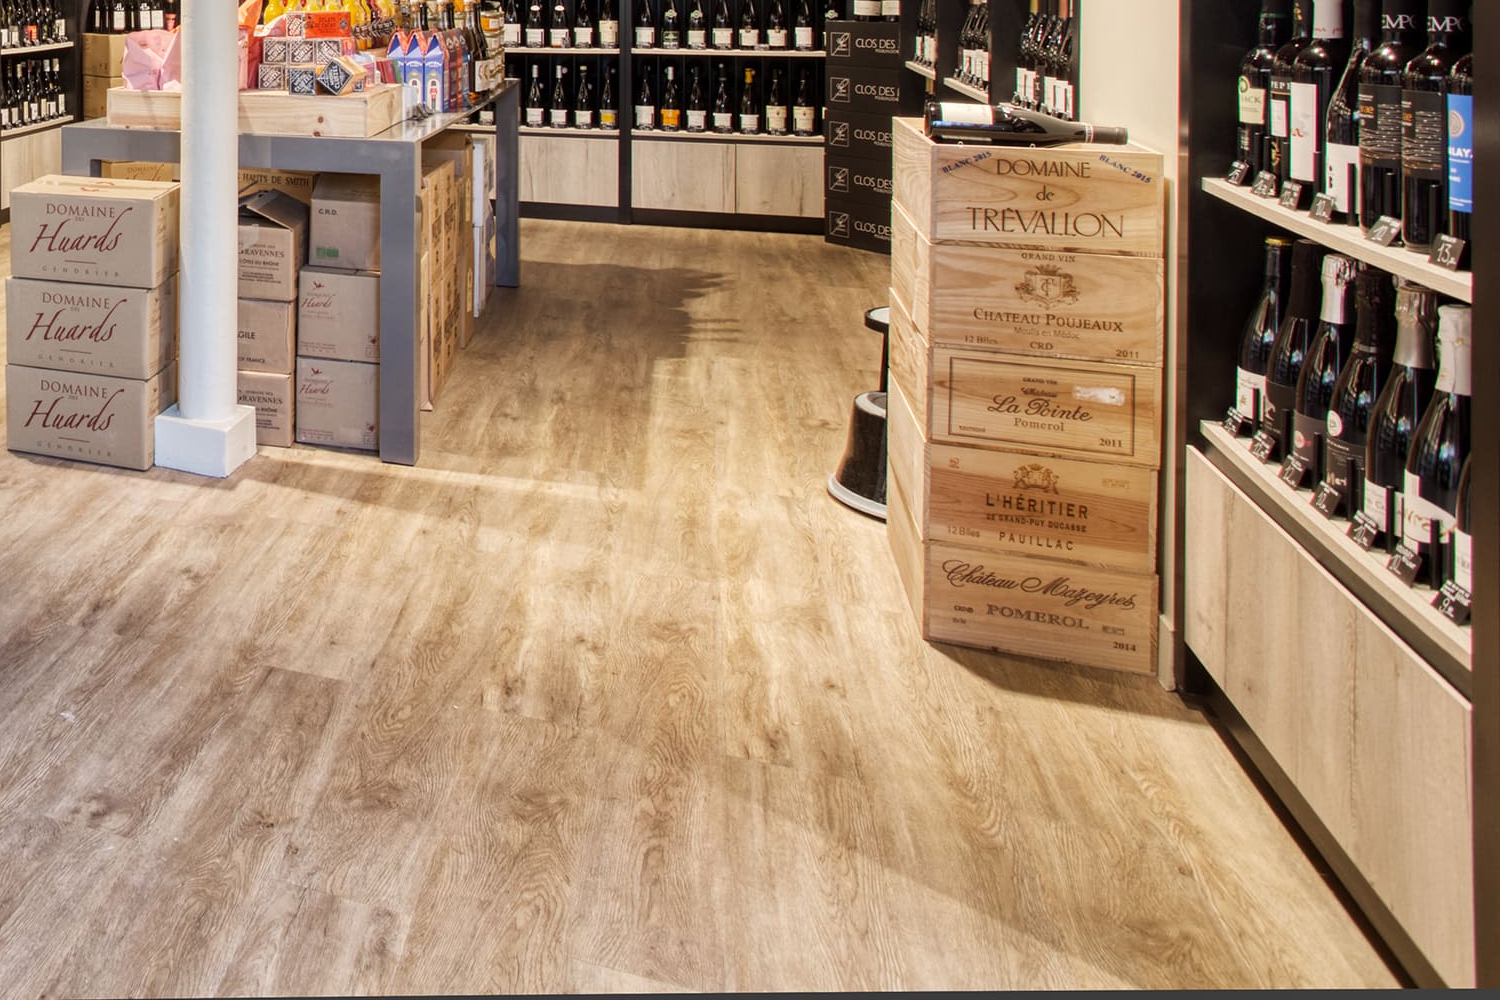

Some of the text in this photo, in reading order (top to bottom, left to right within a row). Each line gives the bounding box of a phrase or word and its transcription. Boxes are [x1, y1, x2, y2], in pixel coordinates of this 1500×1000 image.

[855, 37, 896, 50] CLOS DES
[854, 83, 896, 97] CLOS DES
[854, 128, 876, 141] CLOS
[941, 150, 993, 175] BLANC 2015
[996, 158, 1092, 179] DOMAINE
[1098, 153, 1152, 184] BLANC 2015
[242, 172, 310, 187] HAUTS DE SMITH
[854, 174, 876, 187] CLOS
[1035, 185, 1055, 202] de
[46, 202, 116, 219] DOMAINE
[30, 206, 133, 253] Huards
[854, 220, 876, 233] CLOS
[1021, 251, 1076, 263] GRAND VIN
[41, 291, 111, 310] DOMAINE
[26, 298, 128, 342] Huards
[972, 308, 1124, 333] CHATEAU POUJEAUX
[1029, 340, 1054, 351] CRD
[1115, 348, 1140, 360] 2011
[40, 379, 109, 399] DOMAINE
[23, 388, 125, 432] Huards
[987, 394, 1093, 423] La Pointe
[1013, 417, 1065, 433] Pomerol
[1098, 438, 1124, 449] 2011
[985, 492, 1089, 520] L'HÉRITIER
[999, 514, 1046, 528] GRAND-PUY
[1047, 521, 1088, 533] DUCASSE
[998, 531, 1075, 551] PAUILLAC
[942, 558, 1138, 611] Château Mazeyres
[986, 603, 1091, 630] POMEROL
[1112, 641, 1137, 653] 2014
